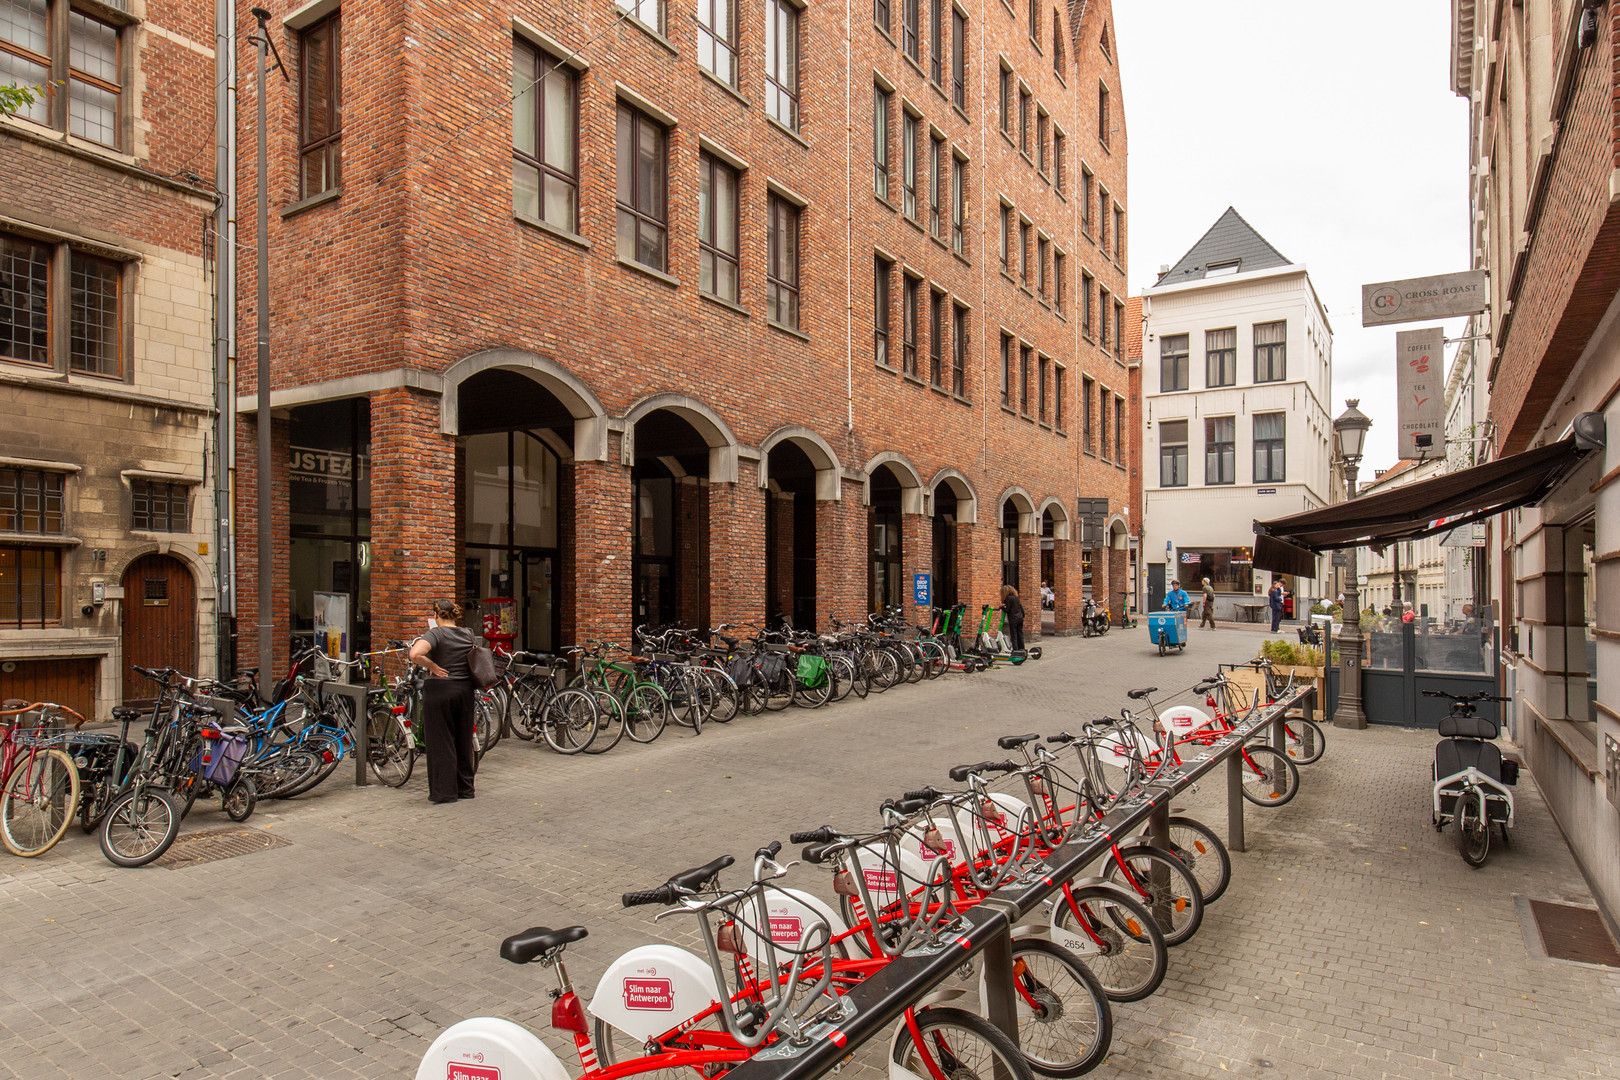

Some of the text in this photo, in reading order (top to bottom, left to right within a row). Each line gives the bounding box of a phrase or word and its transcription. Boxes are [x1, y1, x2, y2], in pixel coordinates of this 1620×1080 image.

[1405, 284, 1478, 300] CROSS ROAST
[1407, 343, 1431, 352] COFFEE
[1402, 422, 1440, 430] CHOCOLATE
[1063, 939, 1085, 950] 2654
[628, 984, 644, 993] Slim
[629, 993, 668, 1004] Antwerpen
[453, 1071, 470, 1080] Slim
